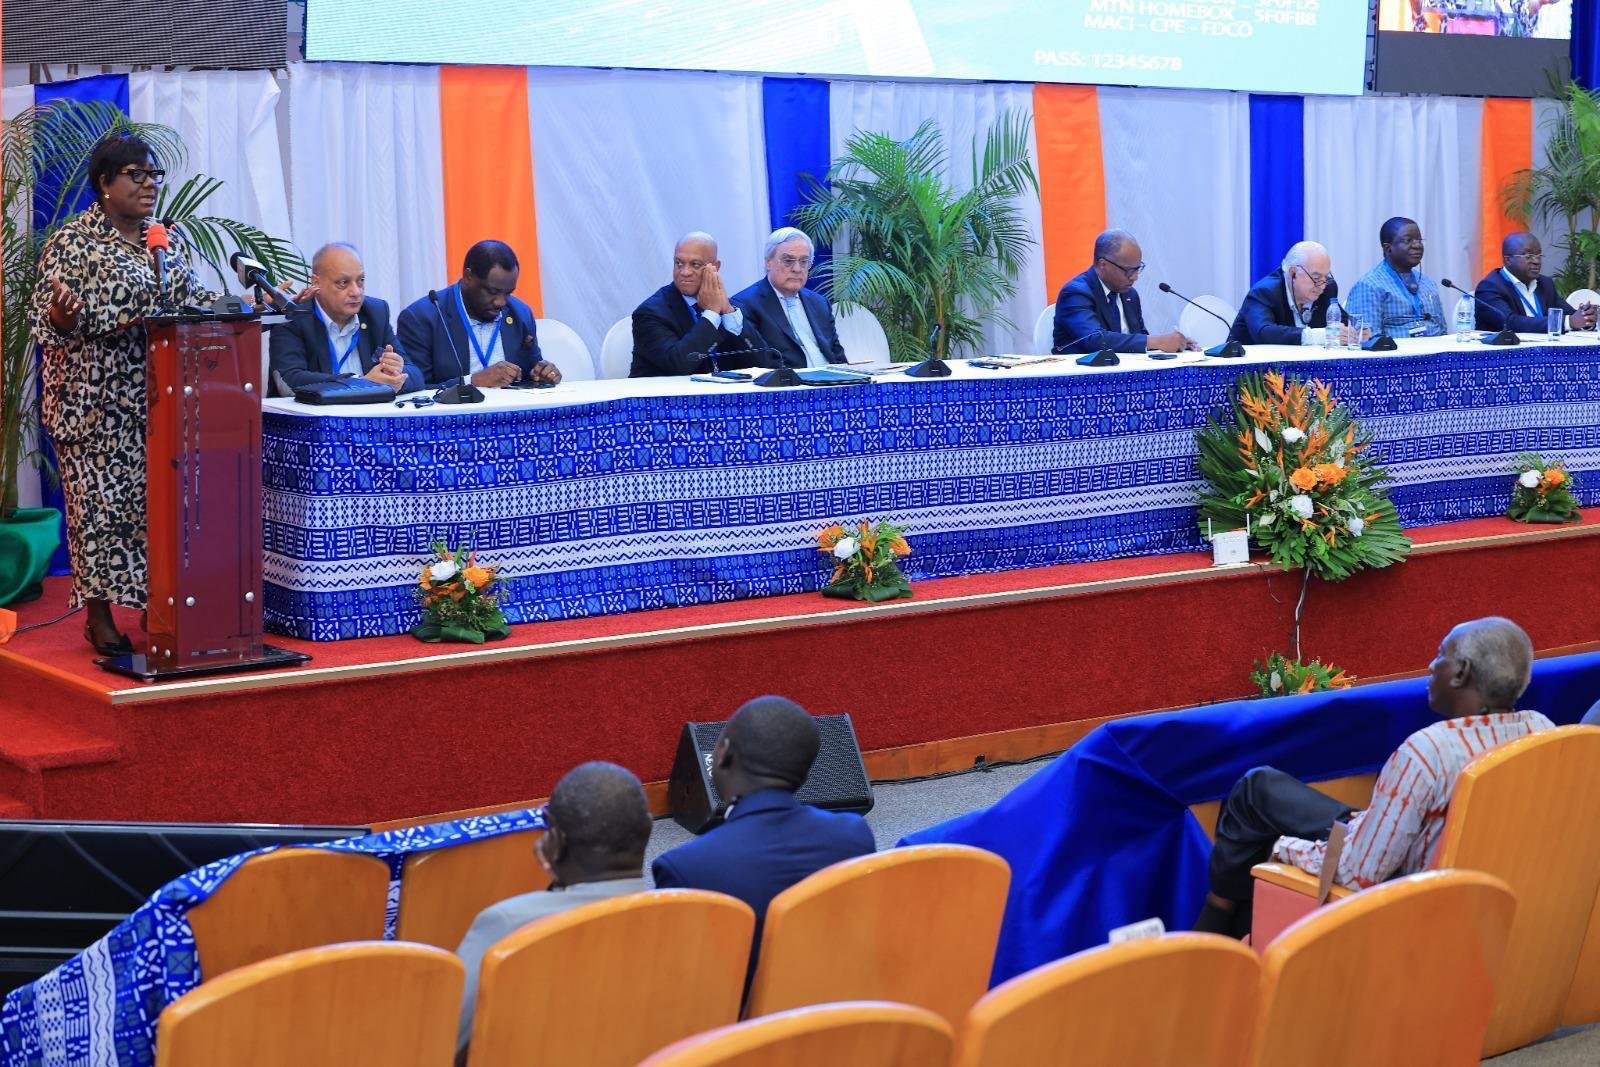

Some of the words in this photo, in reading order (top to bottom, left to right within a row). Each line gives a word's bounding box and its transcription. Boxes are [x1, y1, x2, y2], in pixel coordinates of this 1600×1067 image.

[1091, 0, 1134, 14] MTN
[1139, 1, 1236, 21] HOMEBOX
[1084, 14, 1134, 31] MACI
[1150, 18, 1185, 34] CPE
[1201, 21, 1254, 38] FDCO
[1034, 49, 1087, 67] PASS:
[1092, 54, 1183, 72] 12345678
